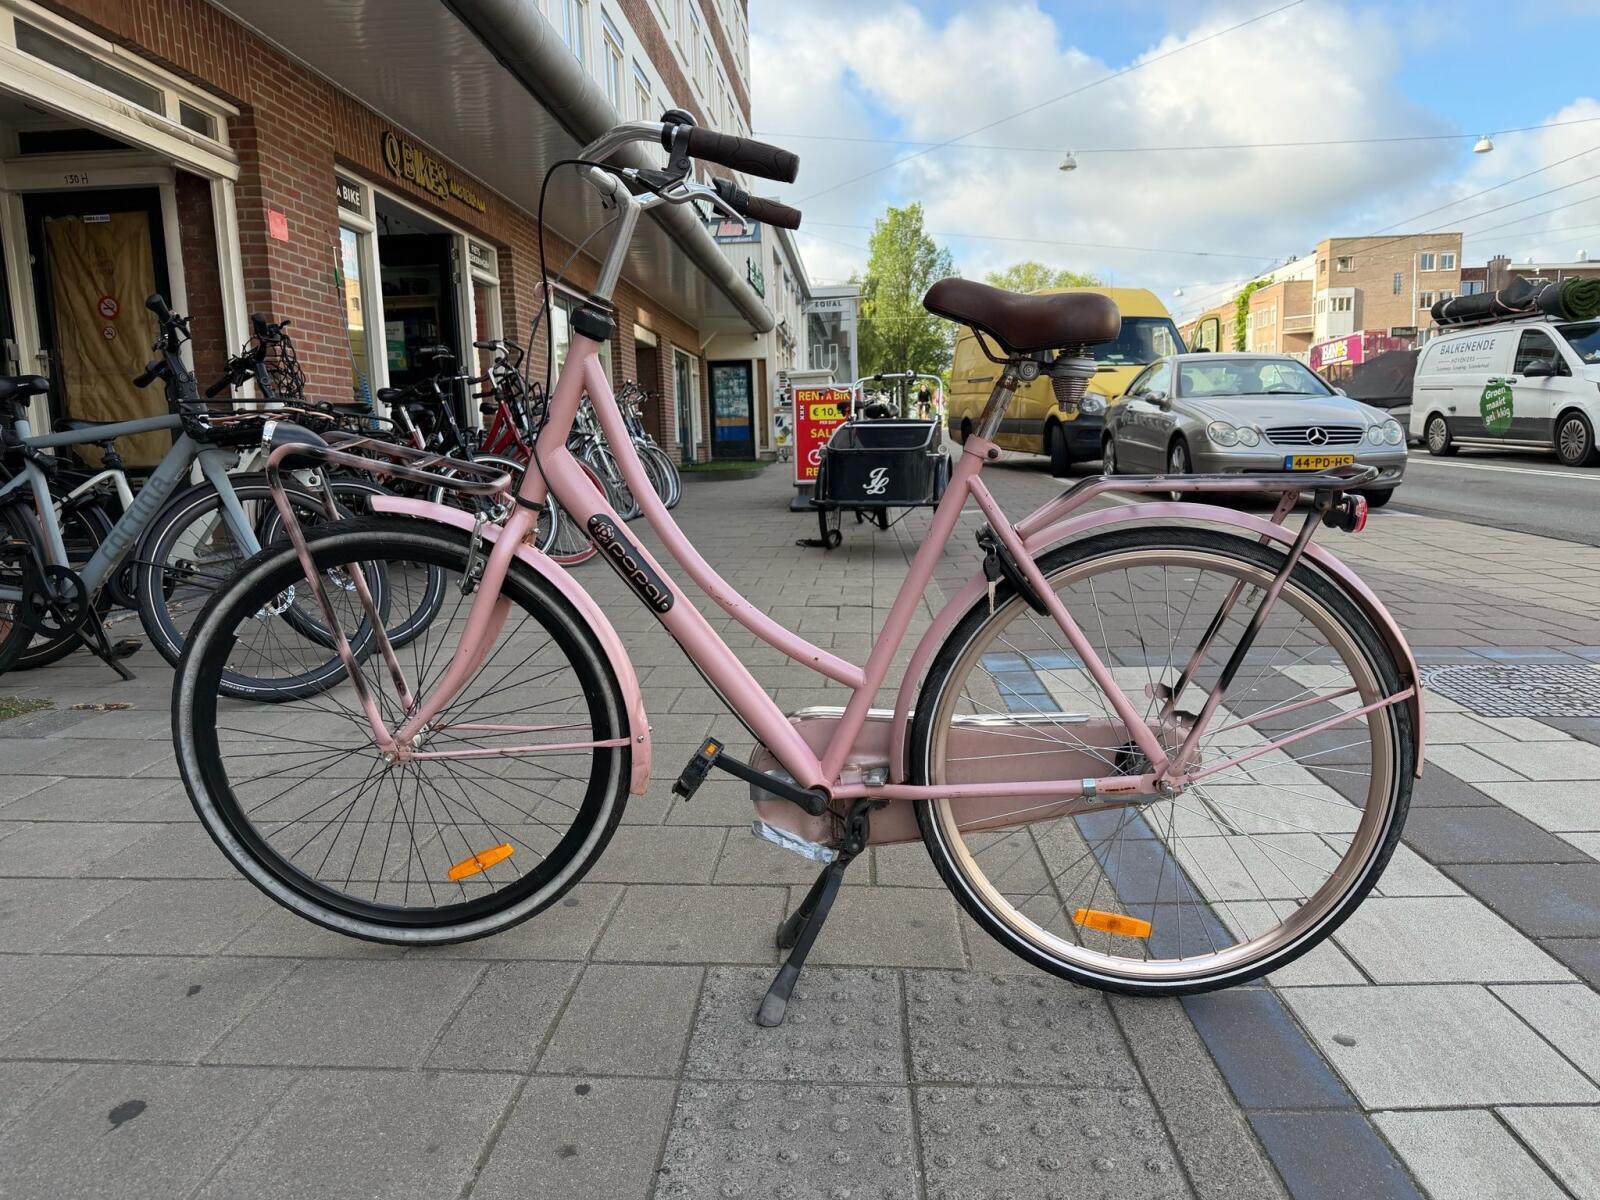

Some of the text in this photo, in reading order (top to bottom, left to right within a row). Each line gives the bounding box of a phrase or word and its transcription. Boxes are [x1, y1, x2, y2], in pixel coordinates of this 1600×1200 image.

[384, 131, 401, 177] Q
[402, 142, 449, 200] BIKES
[342, 186, 361, 206] BIKE
[1440, 339, 1496, 355] BALKENENDE
[833, 391, 850, 400] BIK
[1485, 387, 1506, 400] Groen
[1486, 397, 1507, 411] maakt
[1295, 457, 1350, 467] 44-PD-HS
